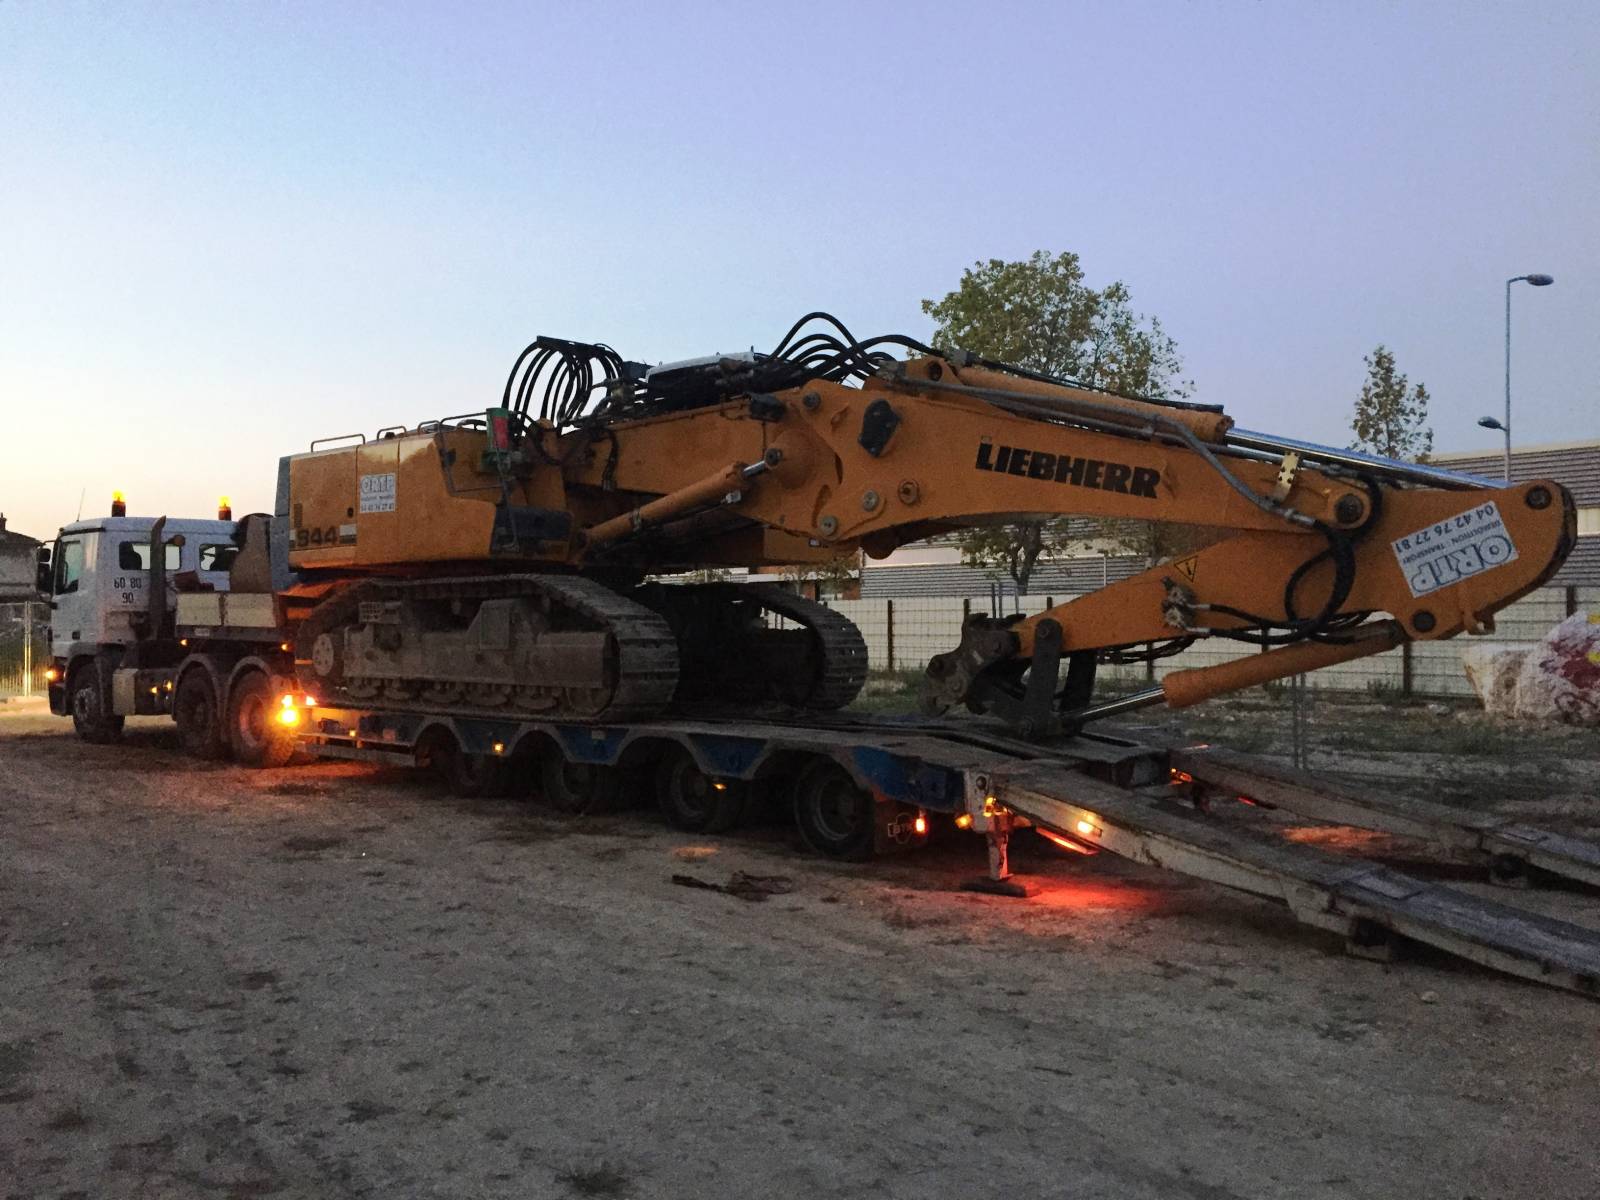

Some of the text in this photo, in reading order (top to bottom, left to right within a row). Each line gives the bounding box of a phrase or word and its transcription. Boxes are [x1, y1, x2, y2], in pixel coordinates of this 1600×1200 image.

[976, 443, 1160, 498] LIEBHERR
[297, 526, 338, 547] 944
[1395, 504, 1494, 553] 04 42 76 27 81
[1403, 543, 1446, 564] TRANSPORT
[1411, 535, 1513, 592] ORTP
[130, 577, 142, 588] 80
[122, 592, 134, 603] 90
